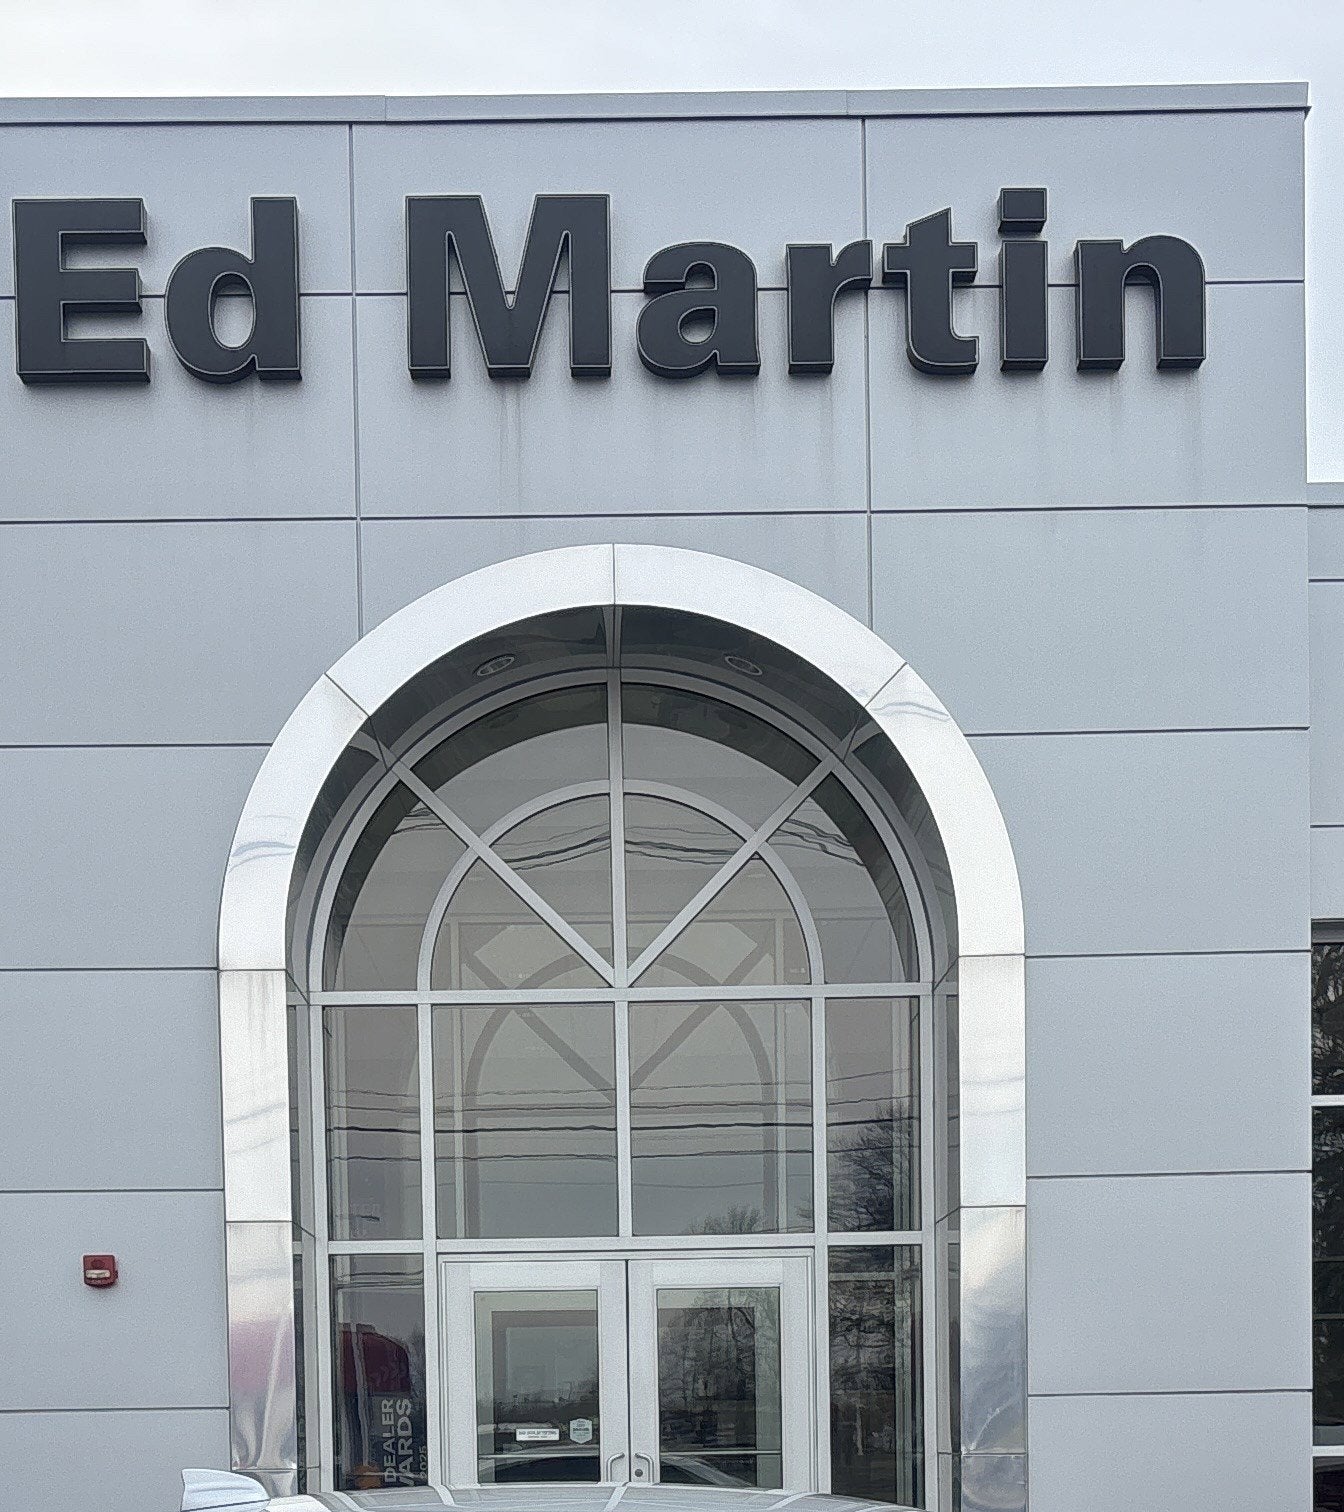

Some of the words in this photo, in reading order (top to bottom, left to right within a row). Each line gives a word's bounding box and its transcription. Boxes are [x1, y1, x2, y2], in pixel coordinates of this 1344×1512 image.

[12, 196, 302, 386] Ed
[405, 187, 1207, 381] Martin
[381, 1399, 396, 1483] DEALER
